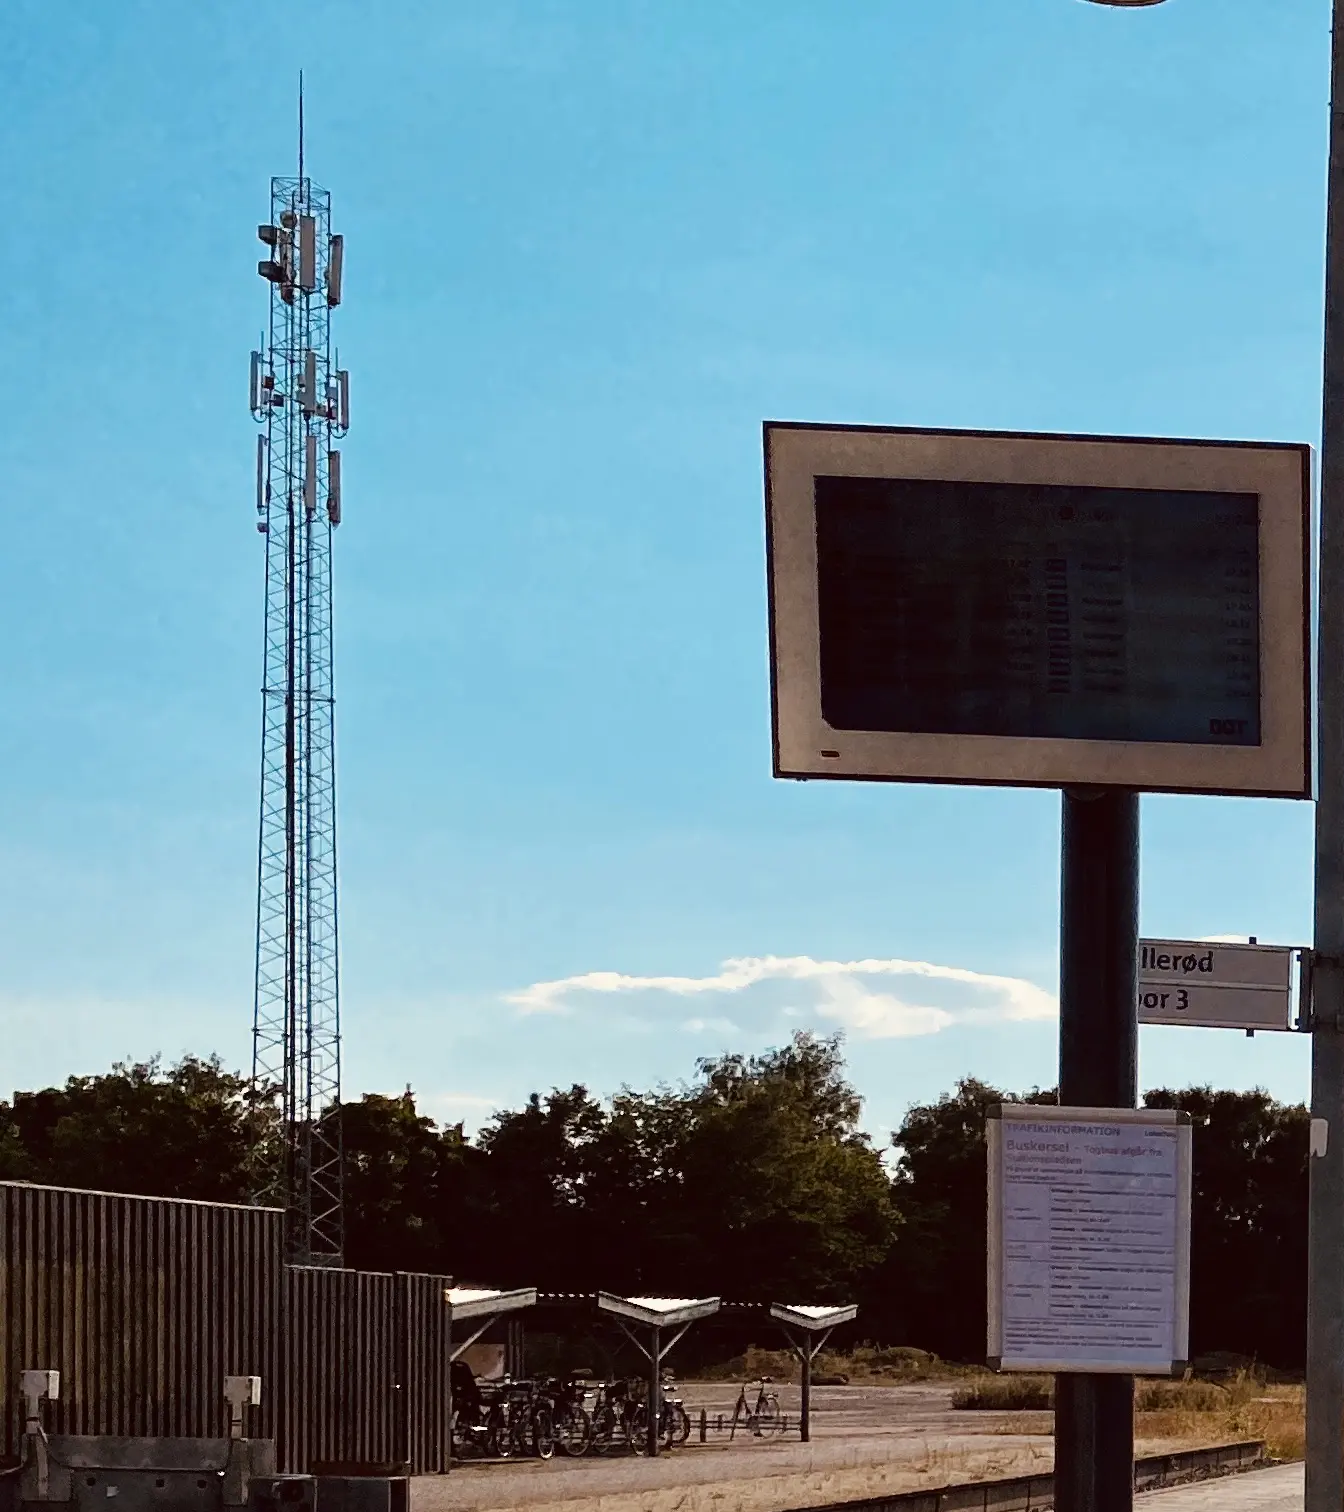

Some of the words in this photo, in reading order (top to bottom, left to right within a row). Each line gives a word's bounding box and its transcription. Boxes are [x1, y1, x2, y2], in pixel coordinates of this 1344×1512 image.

[1141, 946, 1214, 975] llerød
[1139, 992, 1171, 1010] or
[1175, 988, 1190, 1011] 3
[1006, 1123, 1121, 1137] TRAFIKINFORMATION
